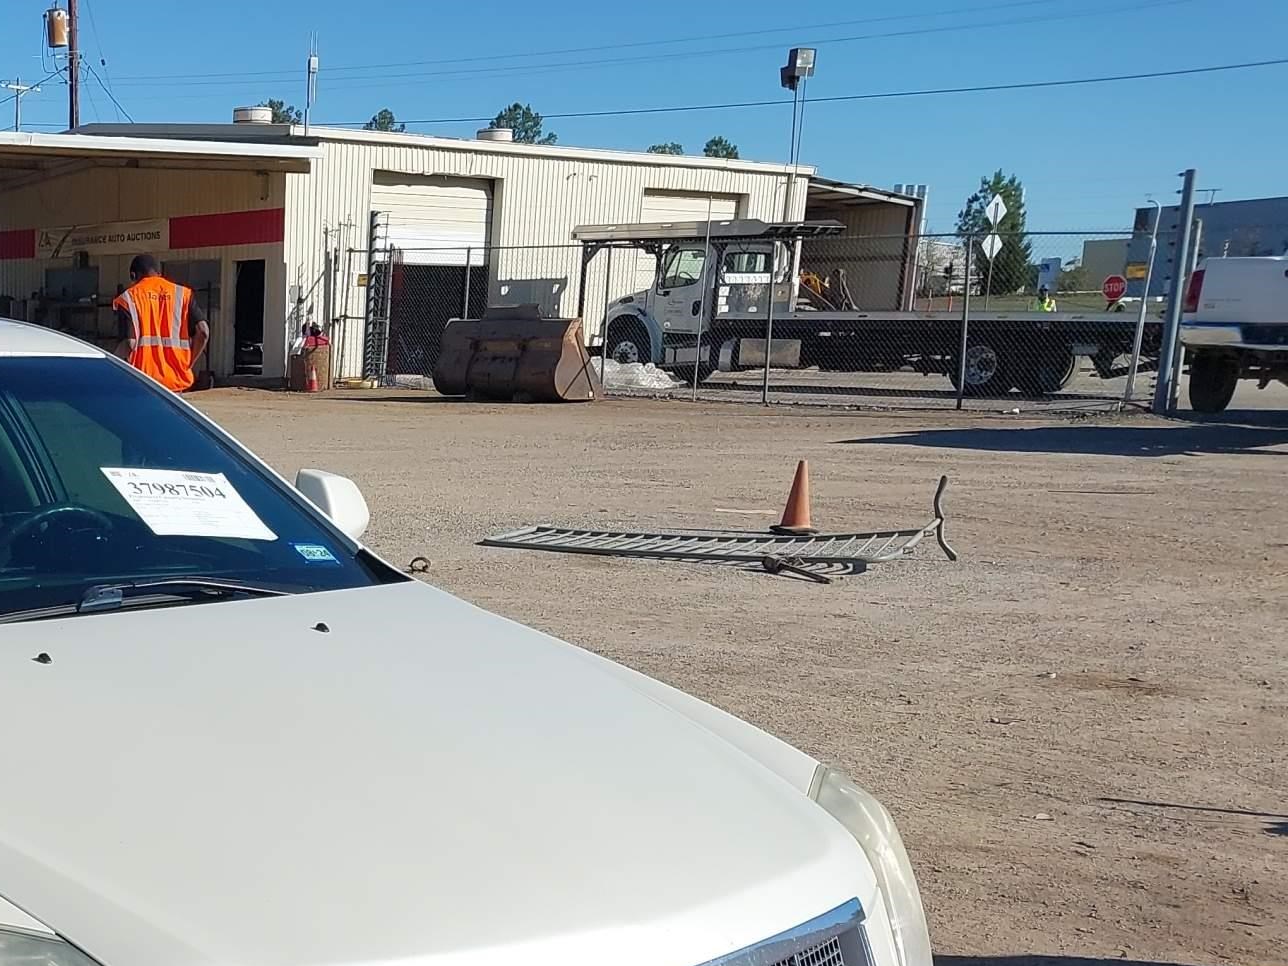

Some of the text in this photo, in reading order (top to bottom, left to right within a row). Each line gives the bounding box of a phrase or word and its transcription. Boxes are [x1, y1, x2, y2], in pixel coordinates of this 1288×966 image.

[108, 233, 126, 243] AUTO
[126, 231, 161, 242] AUCTIONS
[1104, 282, 1125, 293] STOP
[127, 481, 227, 499] 37987504
